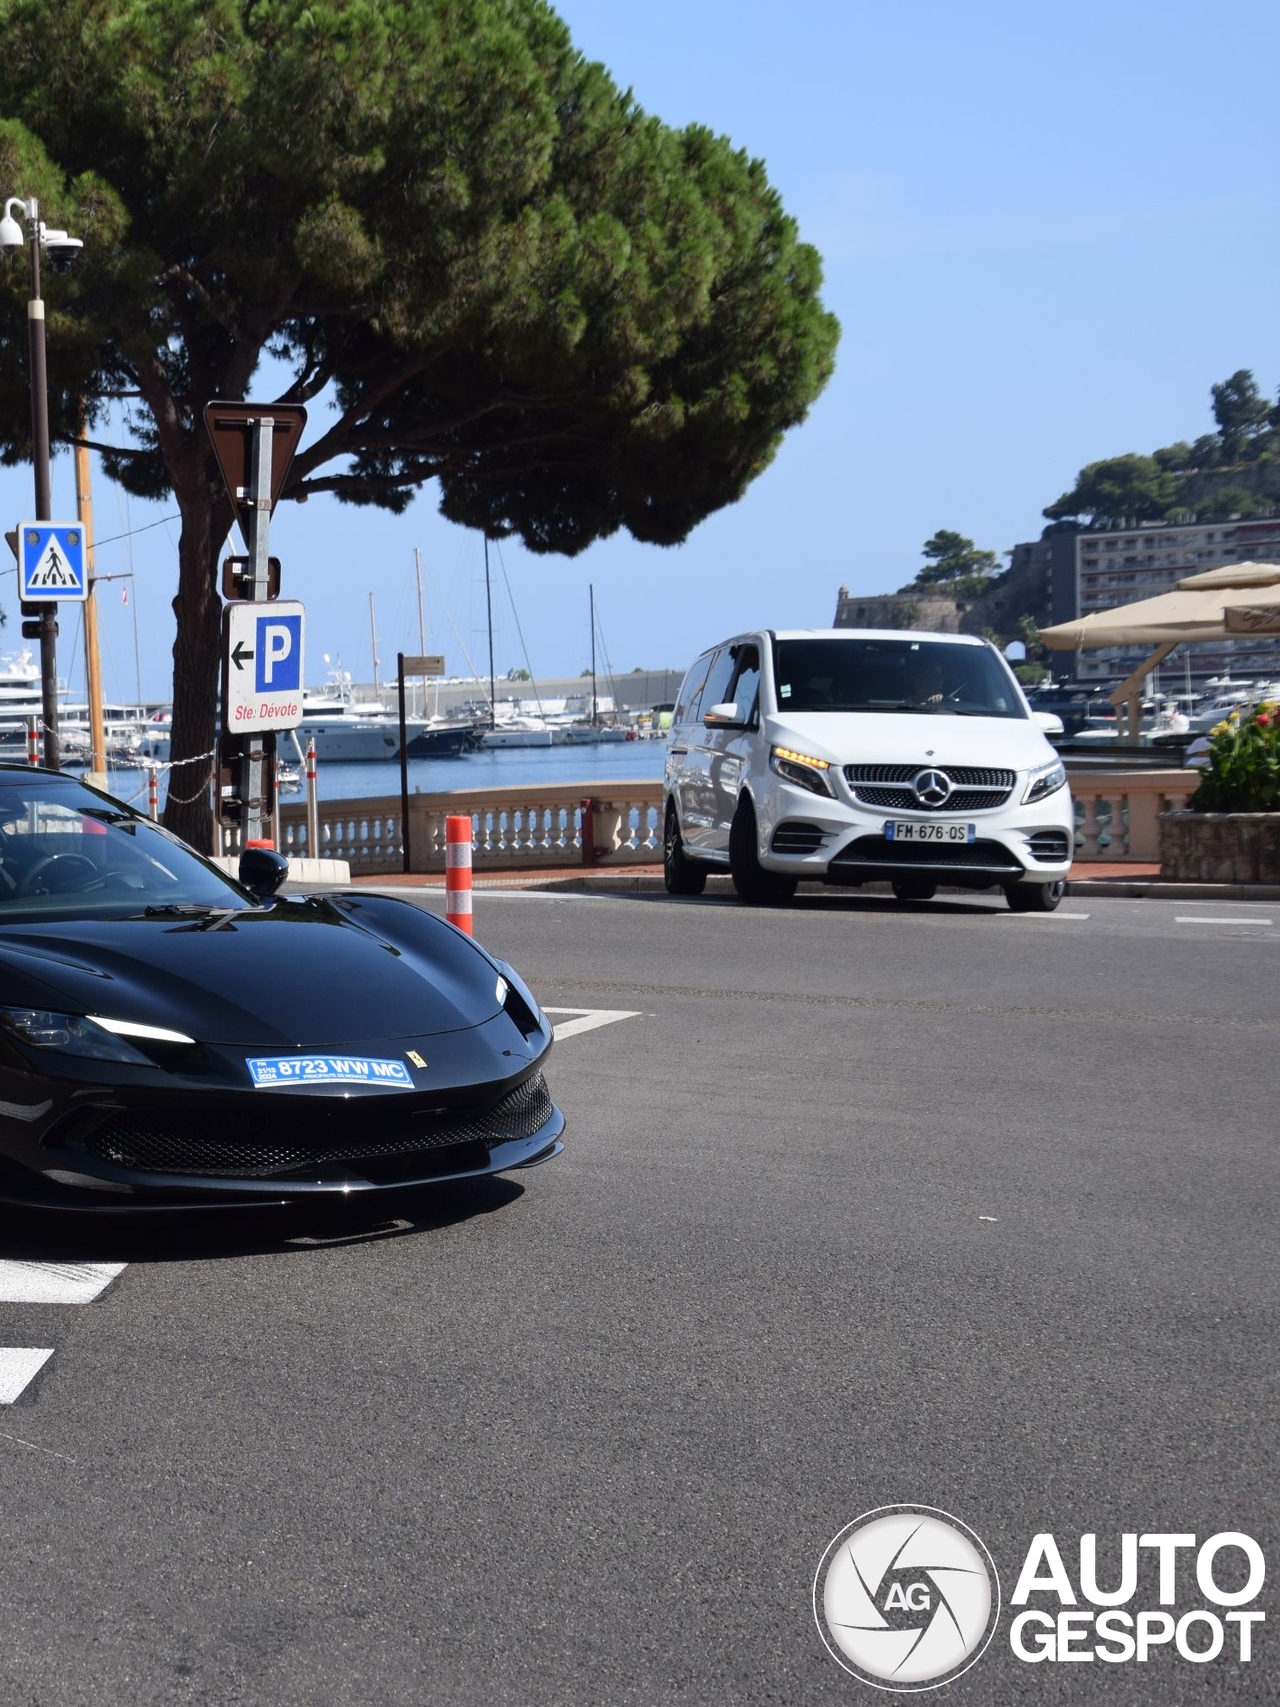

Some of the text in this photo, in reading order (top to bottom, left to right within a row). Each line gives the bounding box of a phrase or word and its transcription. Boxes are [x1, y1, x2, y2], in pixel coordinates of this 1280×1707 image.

[264, 625, 292, 684] P
[260, 702, 298, 718] Dévote
[896, 824, 965, 840] FM-676-QS
[278, 1060, 404, 1078] 8723 WW MC
